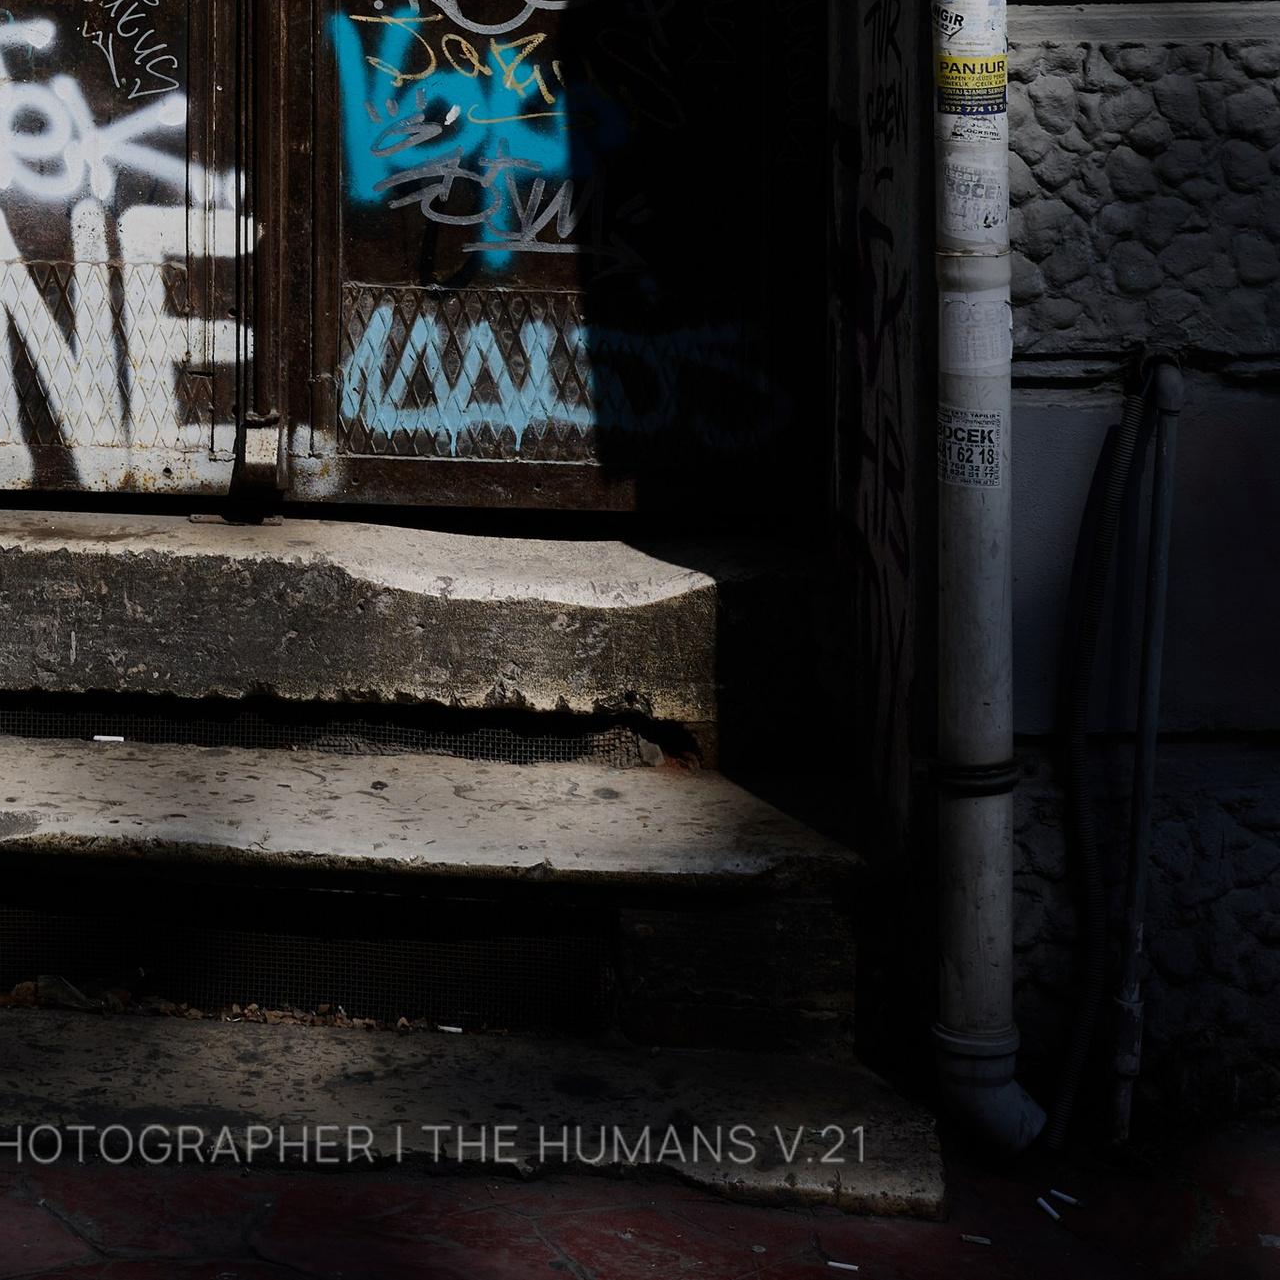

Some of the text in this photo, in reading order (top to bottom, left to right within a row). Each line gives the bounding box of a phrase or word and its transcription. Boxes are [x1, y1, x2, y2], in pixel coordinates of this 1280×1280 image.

[940, 60, 1005, 75] PANJUR
[987, 104, 998, 112] 13
[957, 446, 974, 464] 62
[979, 448, 994, 465] 18
